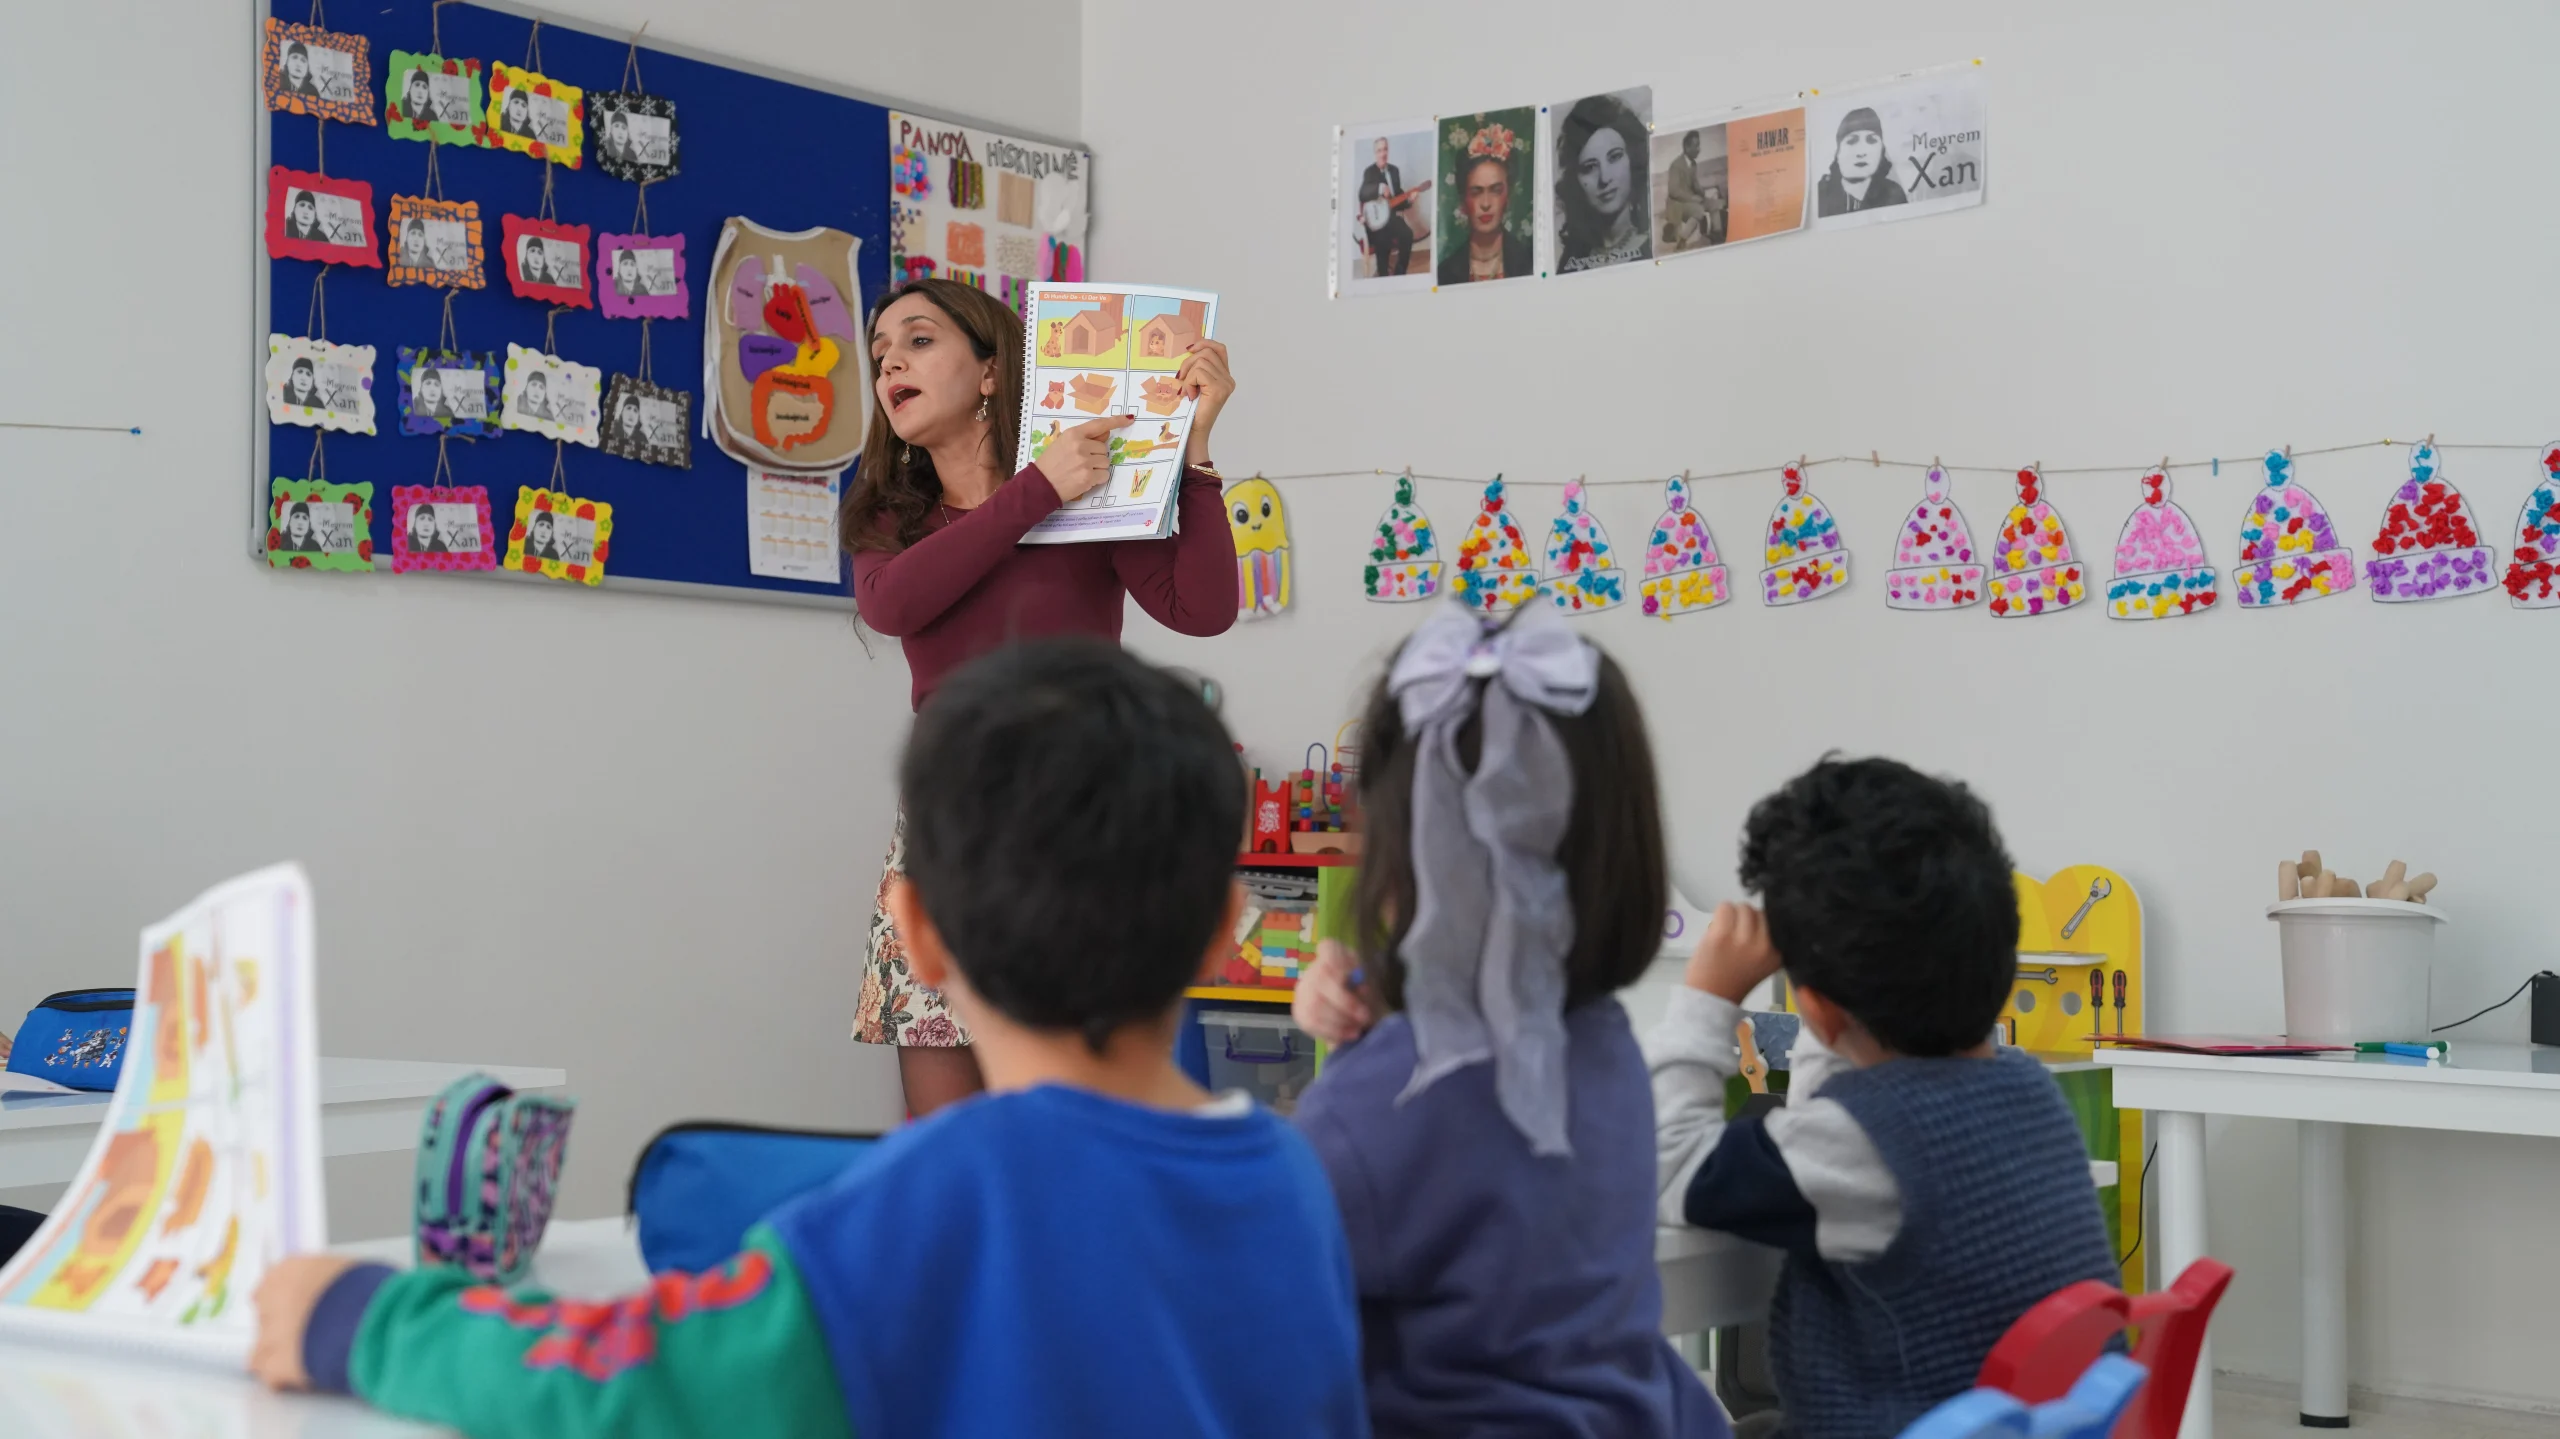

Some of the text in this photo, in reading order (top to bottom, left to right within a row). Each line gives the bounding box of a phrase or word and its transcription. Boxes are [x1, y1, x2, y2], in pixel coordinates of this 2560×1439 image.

[320, 76, 352, 96] Xan
[439, 100, 468, 119] Xan
[901, 120, 974, 162] PANOYA
[1757, 128, 1788, 150] HAWAR
[1912, 130, 1980, 154] Meyrem
[1908, 152, 1976, 193] Xan
[328, 222, 362, 242] Xan
[325, 388, 356, 409] Xan
[454, 396, 484, 412] Xan
[321, 530, 353, 548] Xan
[447, 530, 478, 548] Xan
[561, 541, 589, 562] Xan
